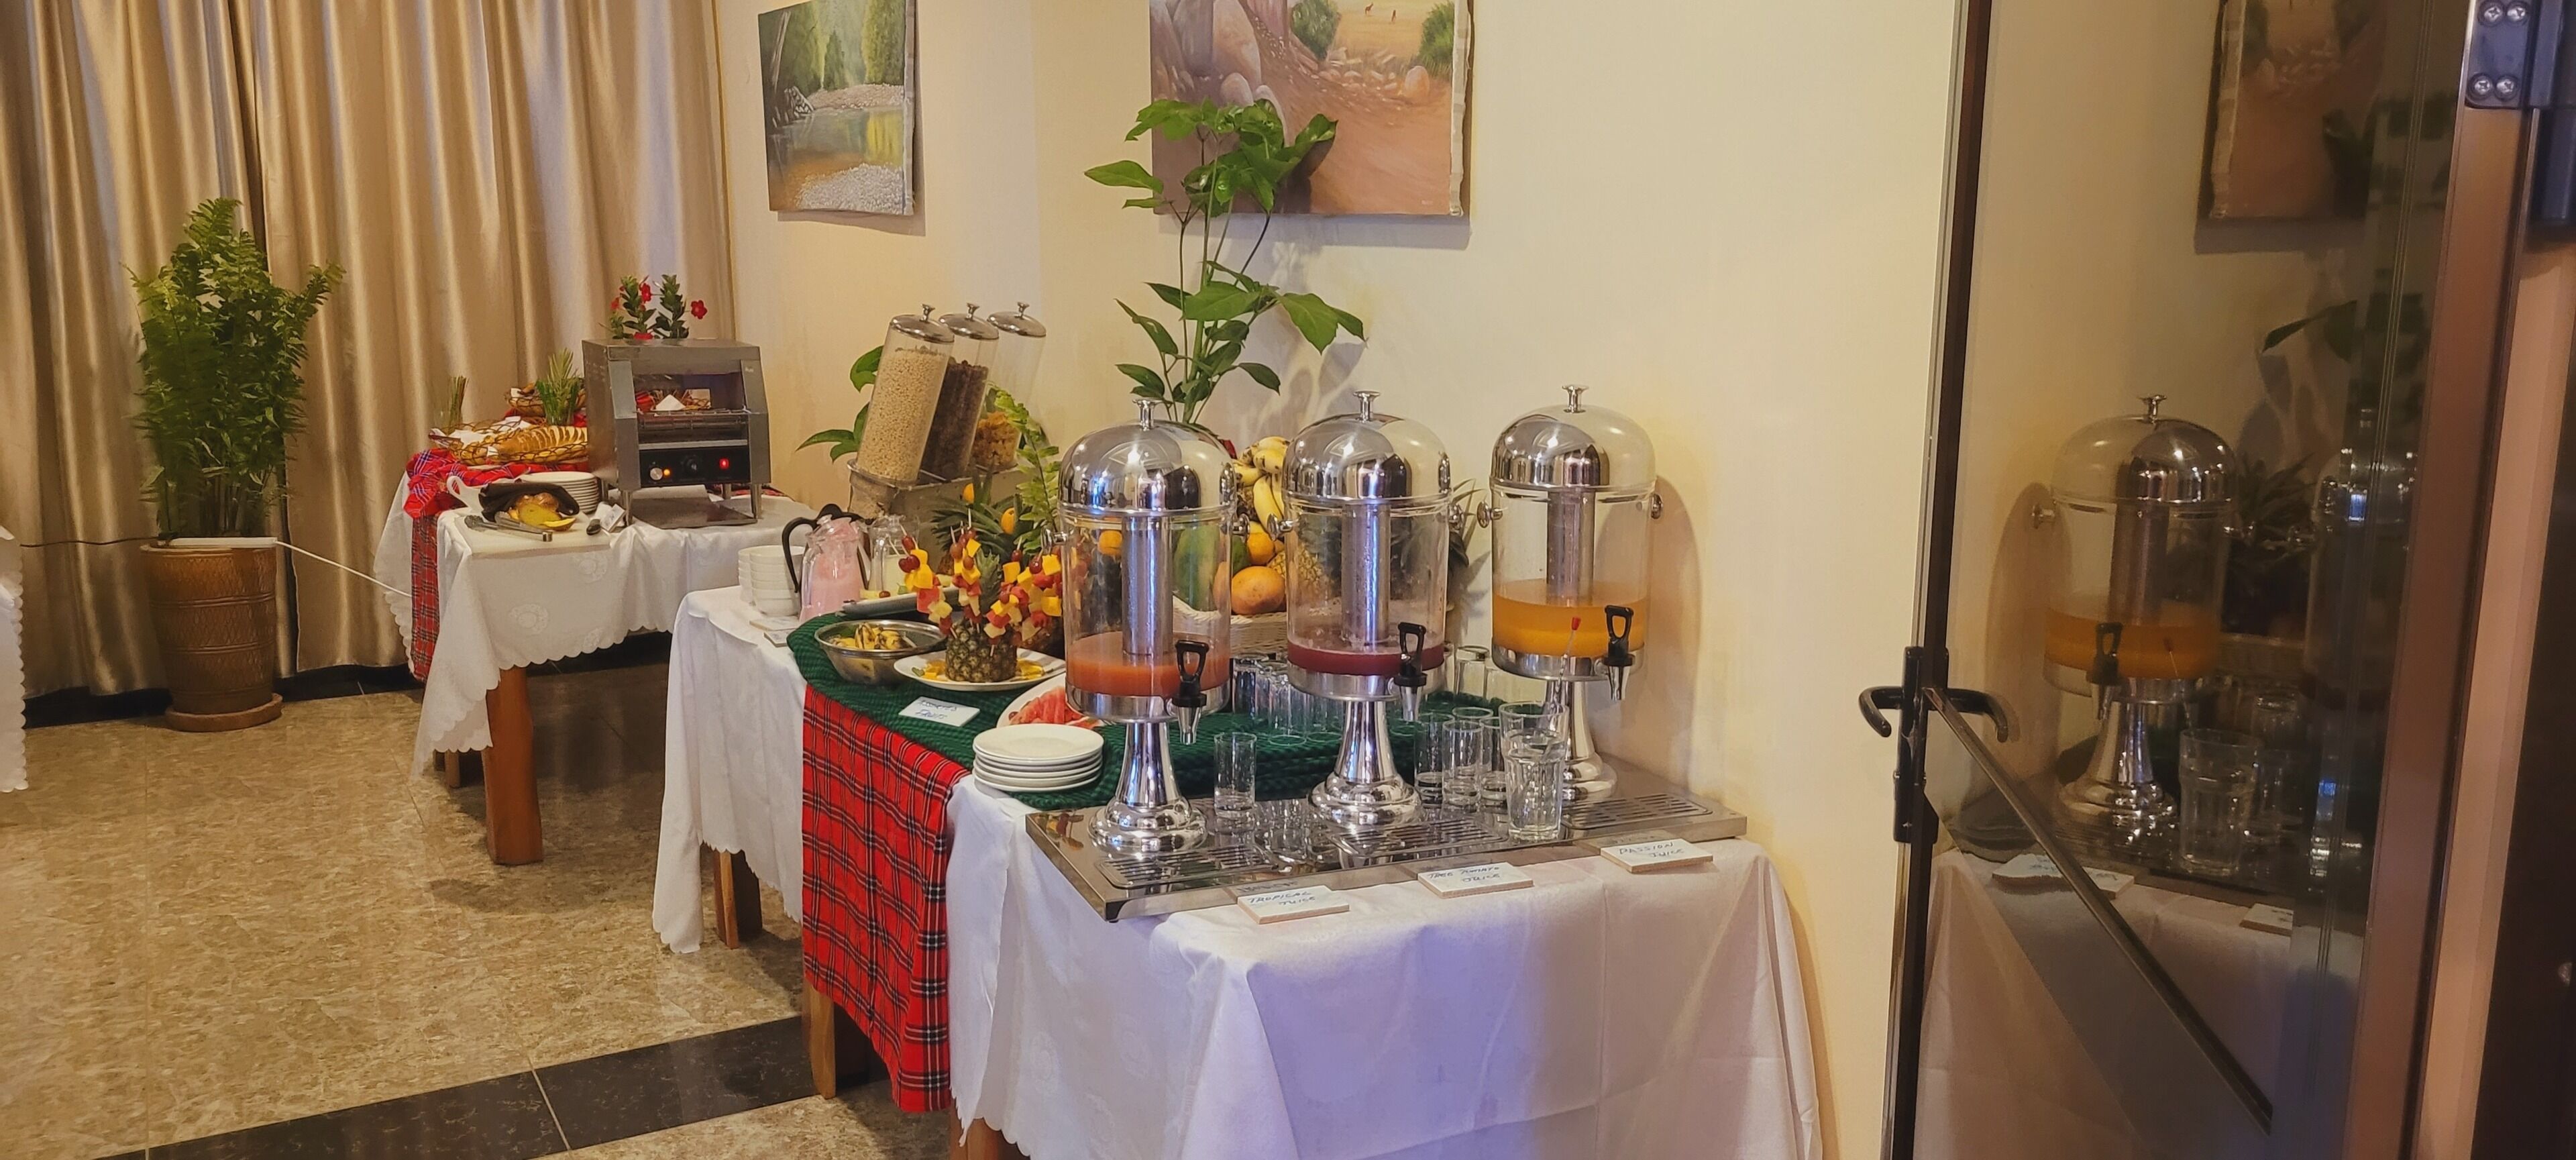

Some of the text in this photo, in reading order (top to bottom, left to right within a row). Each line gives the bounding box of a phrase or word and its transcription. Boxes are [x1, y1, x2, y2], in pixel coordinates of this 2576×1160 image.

[1619, 841, 1674, 855] PASSION
[1648, 848, 1685, 858] JUICE
[1462, 873, 1501, 882] JUICE
[1247, 891, 1312, 904] TROPICAL
[1277, 896, 1316, 906] JUICE
